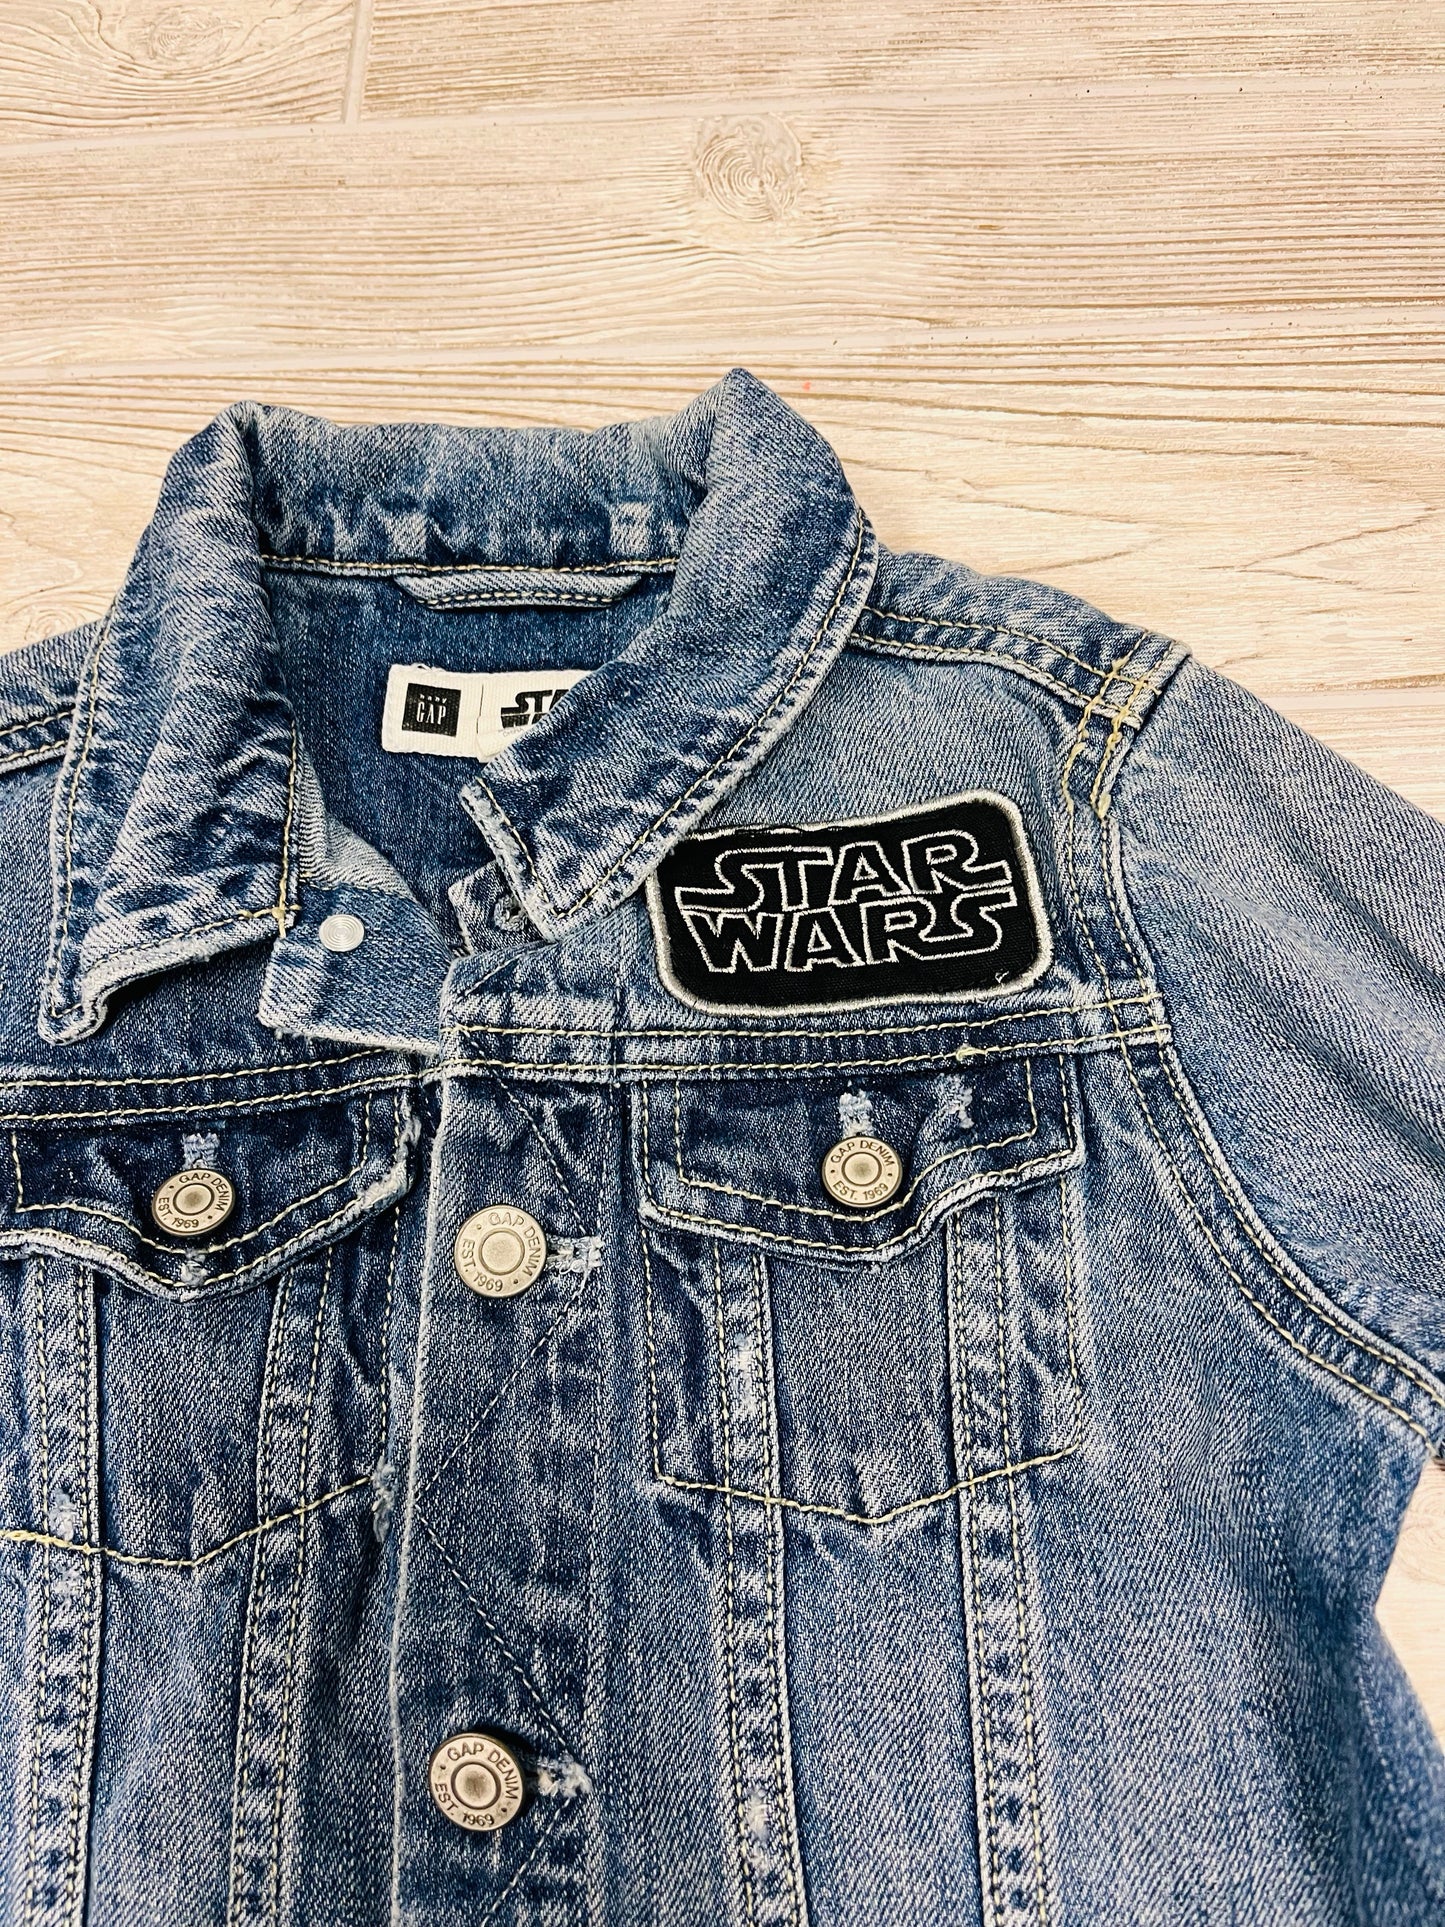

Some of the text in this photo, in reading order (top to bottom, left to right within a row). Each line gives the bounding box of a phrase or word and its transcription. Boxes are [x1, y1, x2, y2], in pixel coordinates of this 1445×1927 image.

[416, 701, 447, 725] GAP
[675, 829, 1013, 912] STAR
[681, 885, 1018, 973] WARS
[830, 1140, 895, 1166] GAP DENIM
[179, 1172, 230, 1212] GAP DENIM
[833, 1180, 889, 1201] EST. 1969
[158, 1197, 200, 1229] EST. 1969
[461, 1238, 503, 1292] EST. 1969
[488, 1212, 542, 1277] GAP DENIM
[447, 1741, 519, 1800] GAP DENIM
[434, 1783, 495, 1827] EST. 1969
